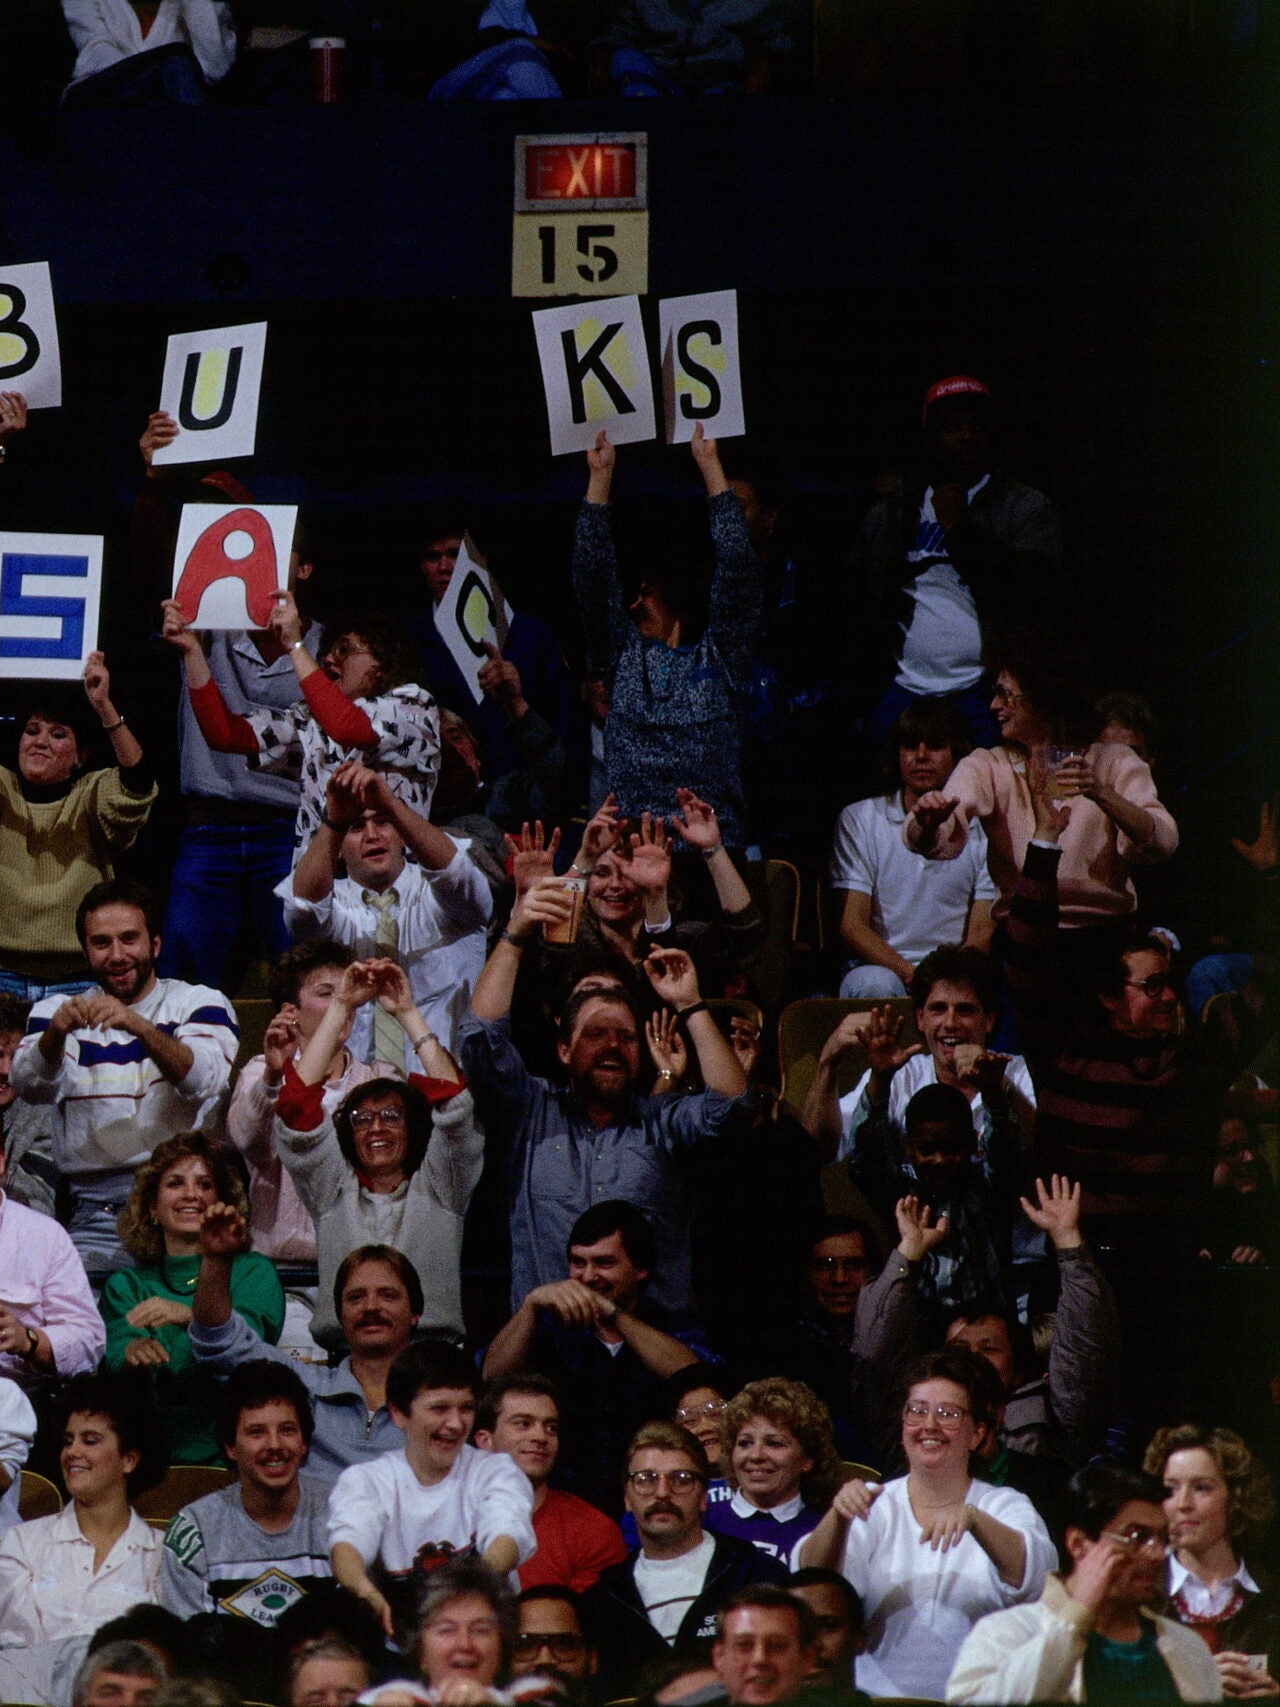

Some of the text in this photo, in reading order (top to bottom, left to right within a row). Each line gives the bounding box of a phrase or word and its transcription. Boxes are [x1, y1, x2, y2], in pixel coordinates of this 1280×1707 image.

[537, 148, 631, 197] EXIT
[539, 225, 619, 284] 15
[179, 346, 243, 431] U
[561, 322, 636, 424] K
[677, 319, 722, 420] S
[175, 508, 280, 630] A
[250, 1608, 280, 1622] LEA
[254, 1581, 296, 1597] RUGBY
